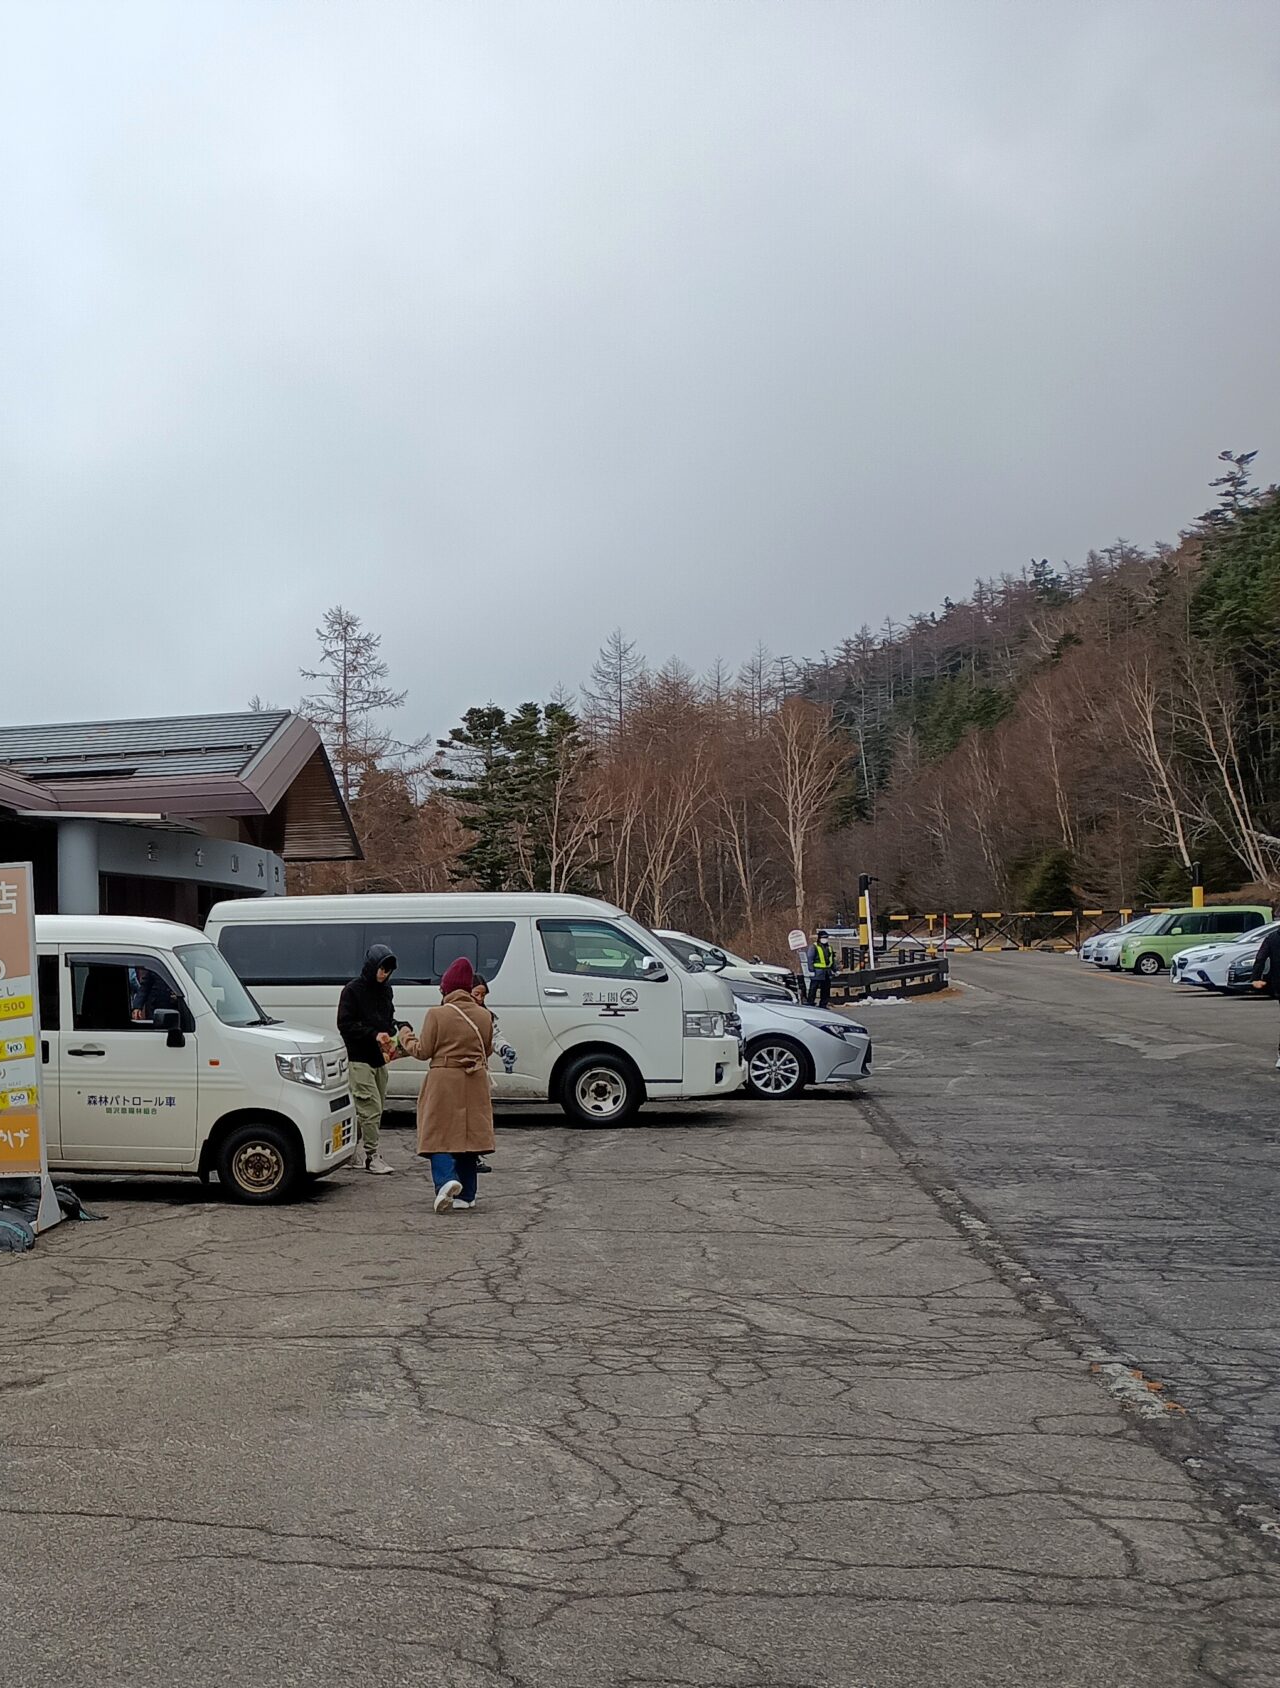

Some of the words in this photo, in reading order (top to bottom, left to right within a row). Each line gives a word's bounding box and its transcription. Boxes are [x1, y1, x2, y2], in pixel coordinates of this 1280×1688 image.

[87, 1095, 176, 1107] 森林パトロール車
